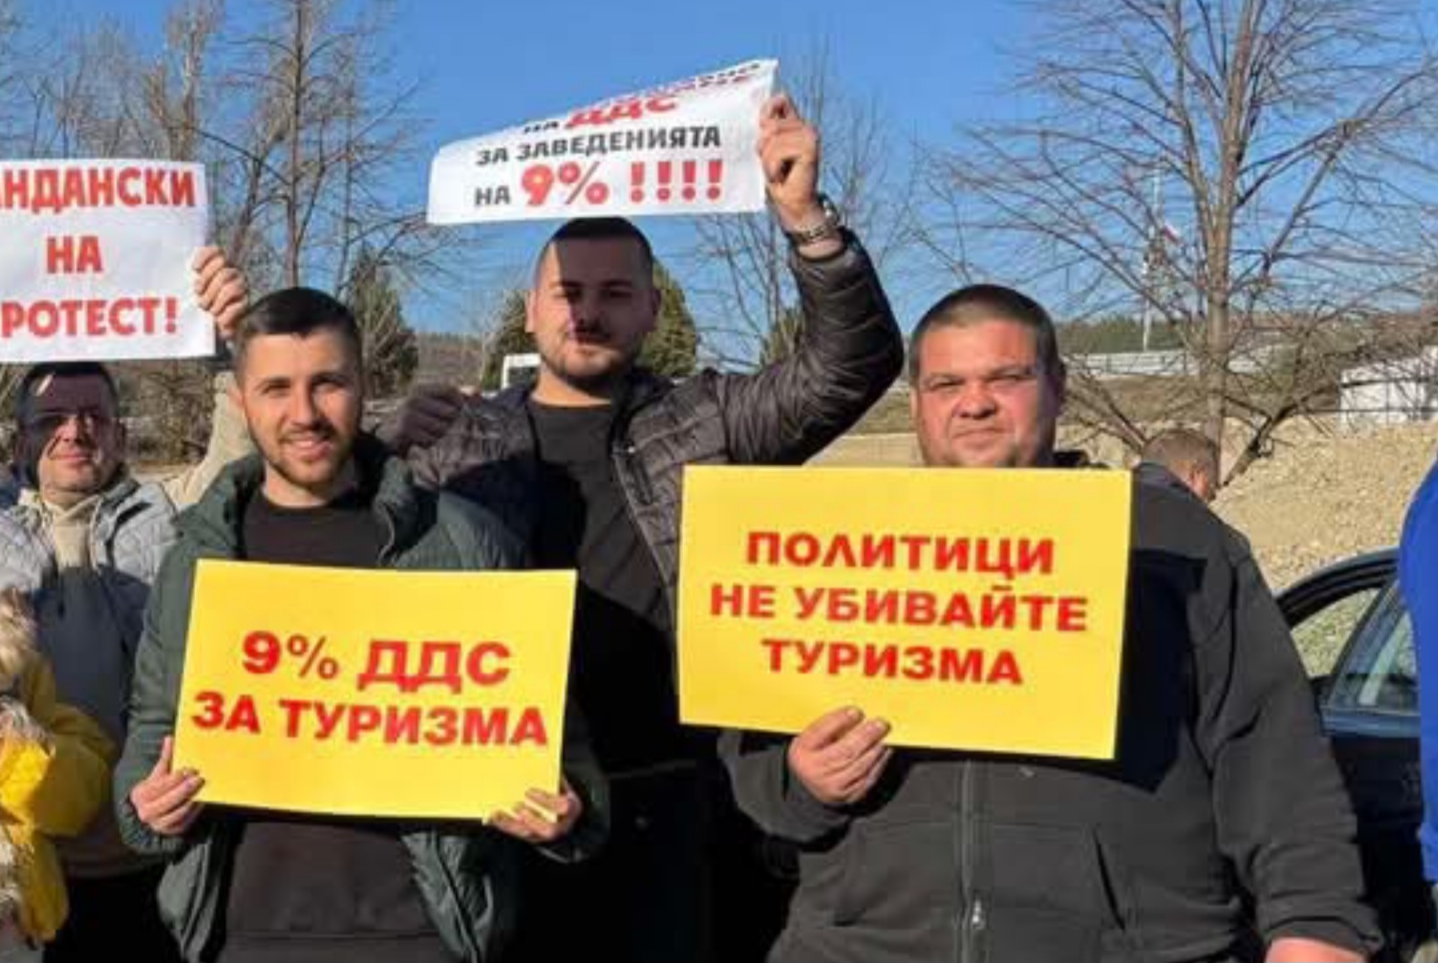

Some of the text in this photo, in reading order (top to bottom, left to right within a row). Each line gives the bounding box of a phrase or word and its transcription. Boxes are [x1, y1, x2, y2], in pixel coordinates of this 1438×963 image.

[475, 125, 722, 166] ЗА ЗАВЕДЕНИЯТА
[473, 159, 724, 207] НА 9% !!!!
[45, 236, 104, 274] НА
[746, 530, 1056, 581] ПОЛИТИЦИ
[709, 584, 1088, 633] НЕ УБИВАЙТЕ
[241, 630, 513, 695] 9% ДДС
[762, 638, 1024, 685] ТУРИЗМА
[191, 690, 549, 747] ЗА ТУРИЗМА
